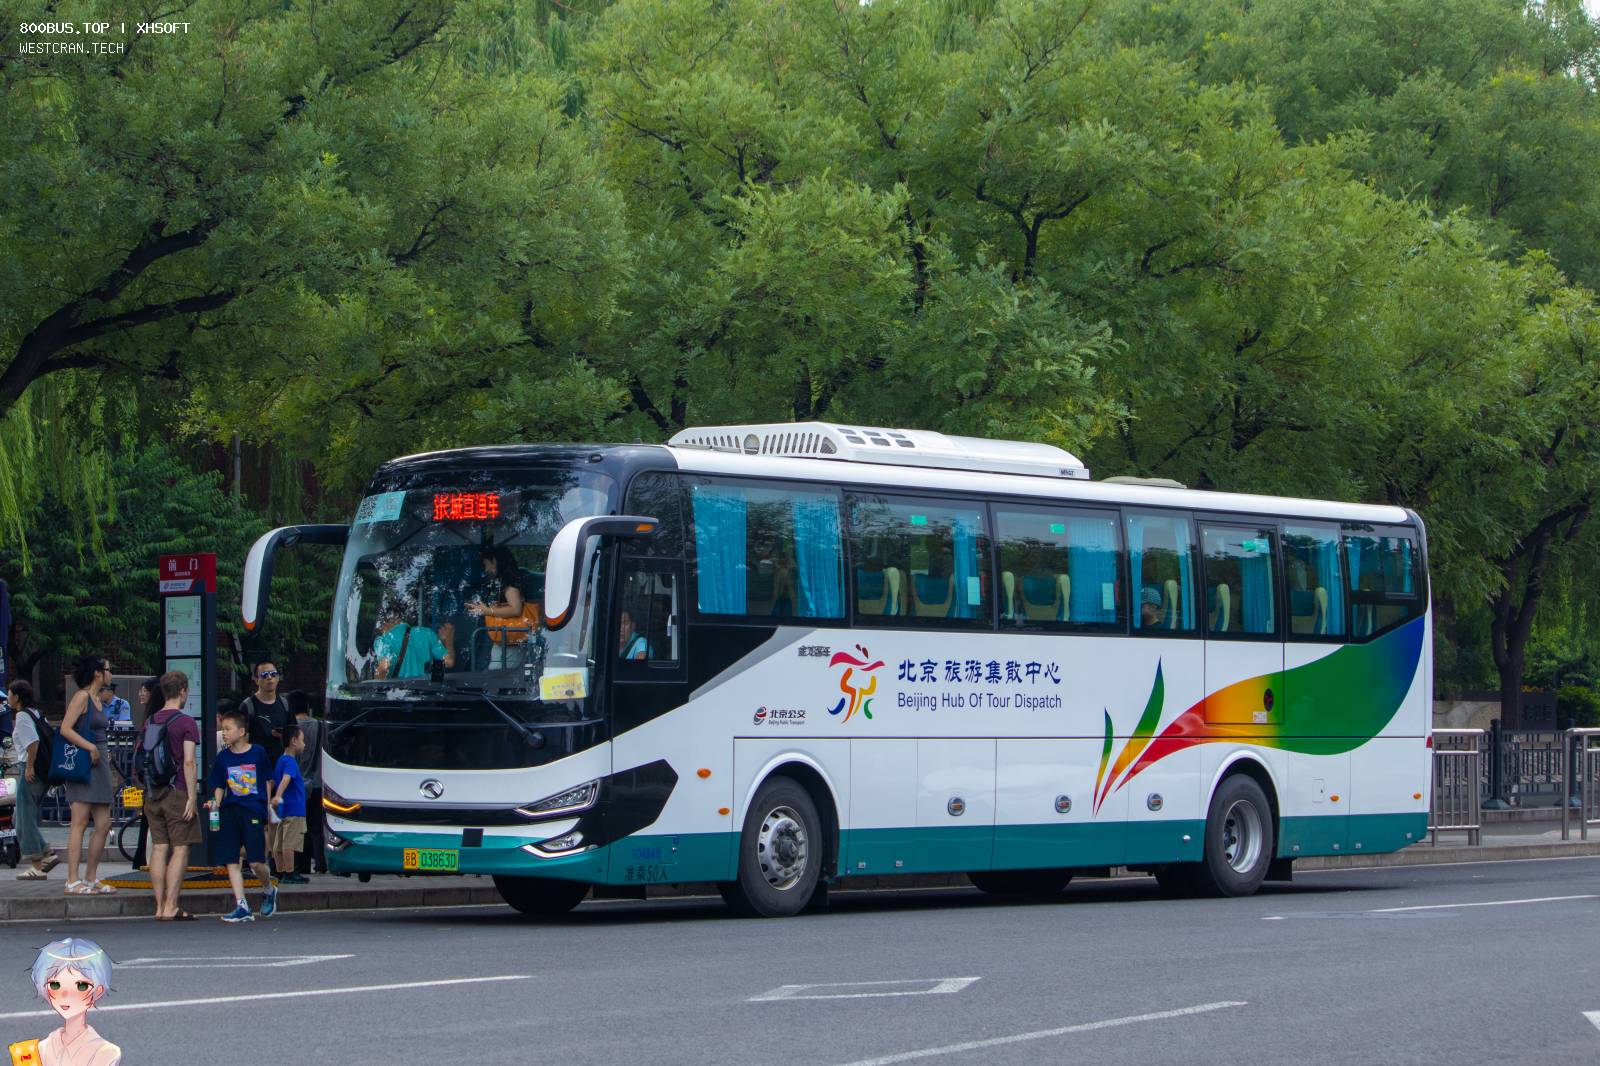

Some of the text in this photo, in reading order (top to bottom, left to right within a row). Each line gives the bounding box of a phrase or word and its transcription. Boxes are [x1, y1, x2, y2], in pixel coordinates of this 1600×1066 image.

[898, 692, 1062, 711] Beijing Hub Of Tour Dispatch
[769, 709, 806, 719] 北京公交
